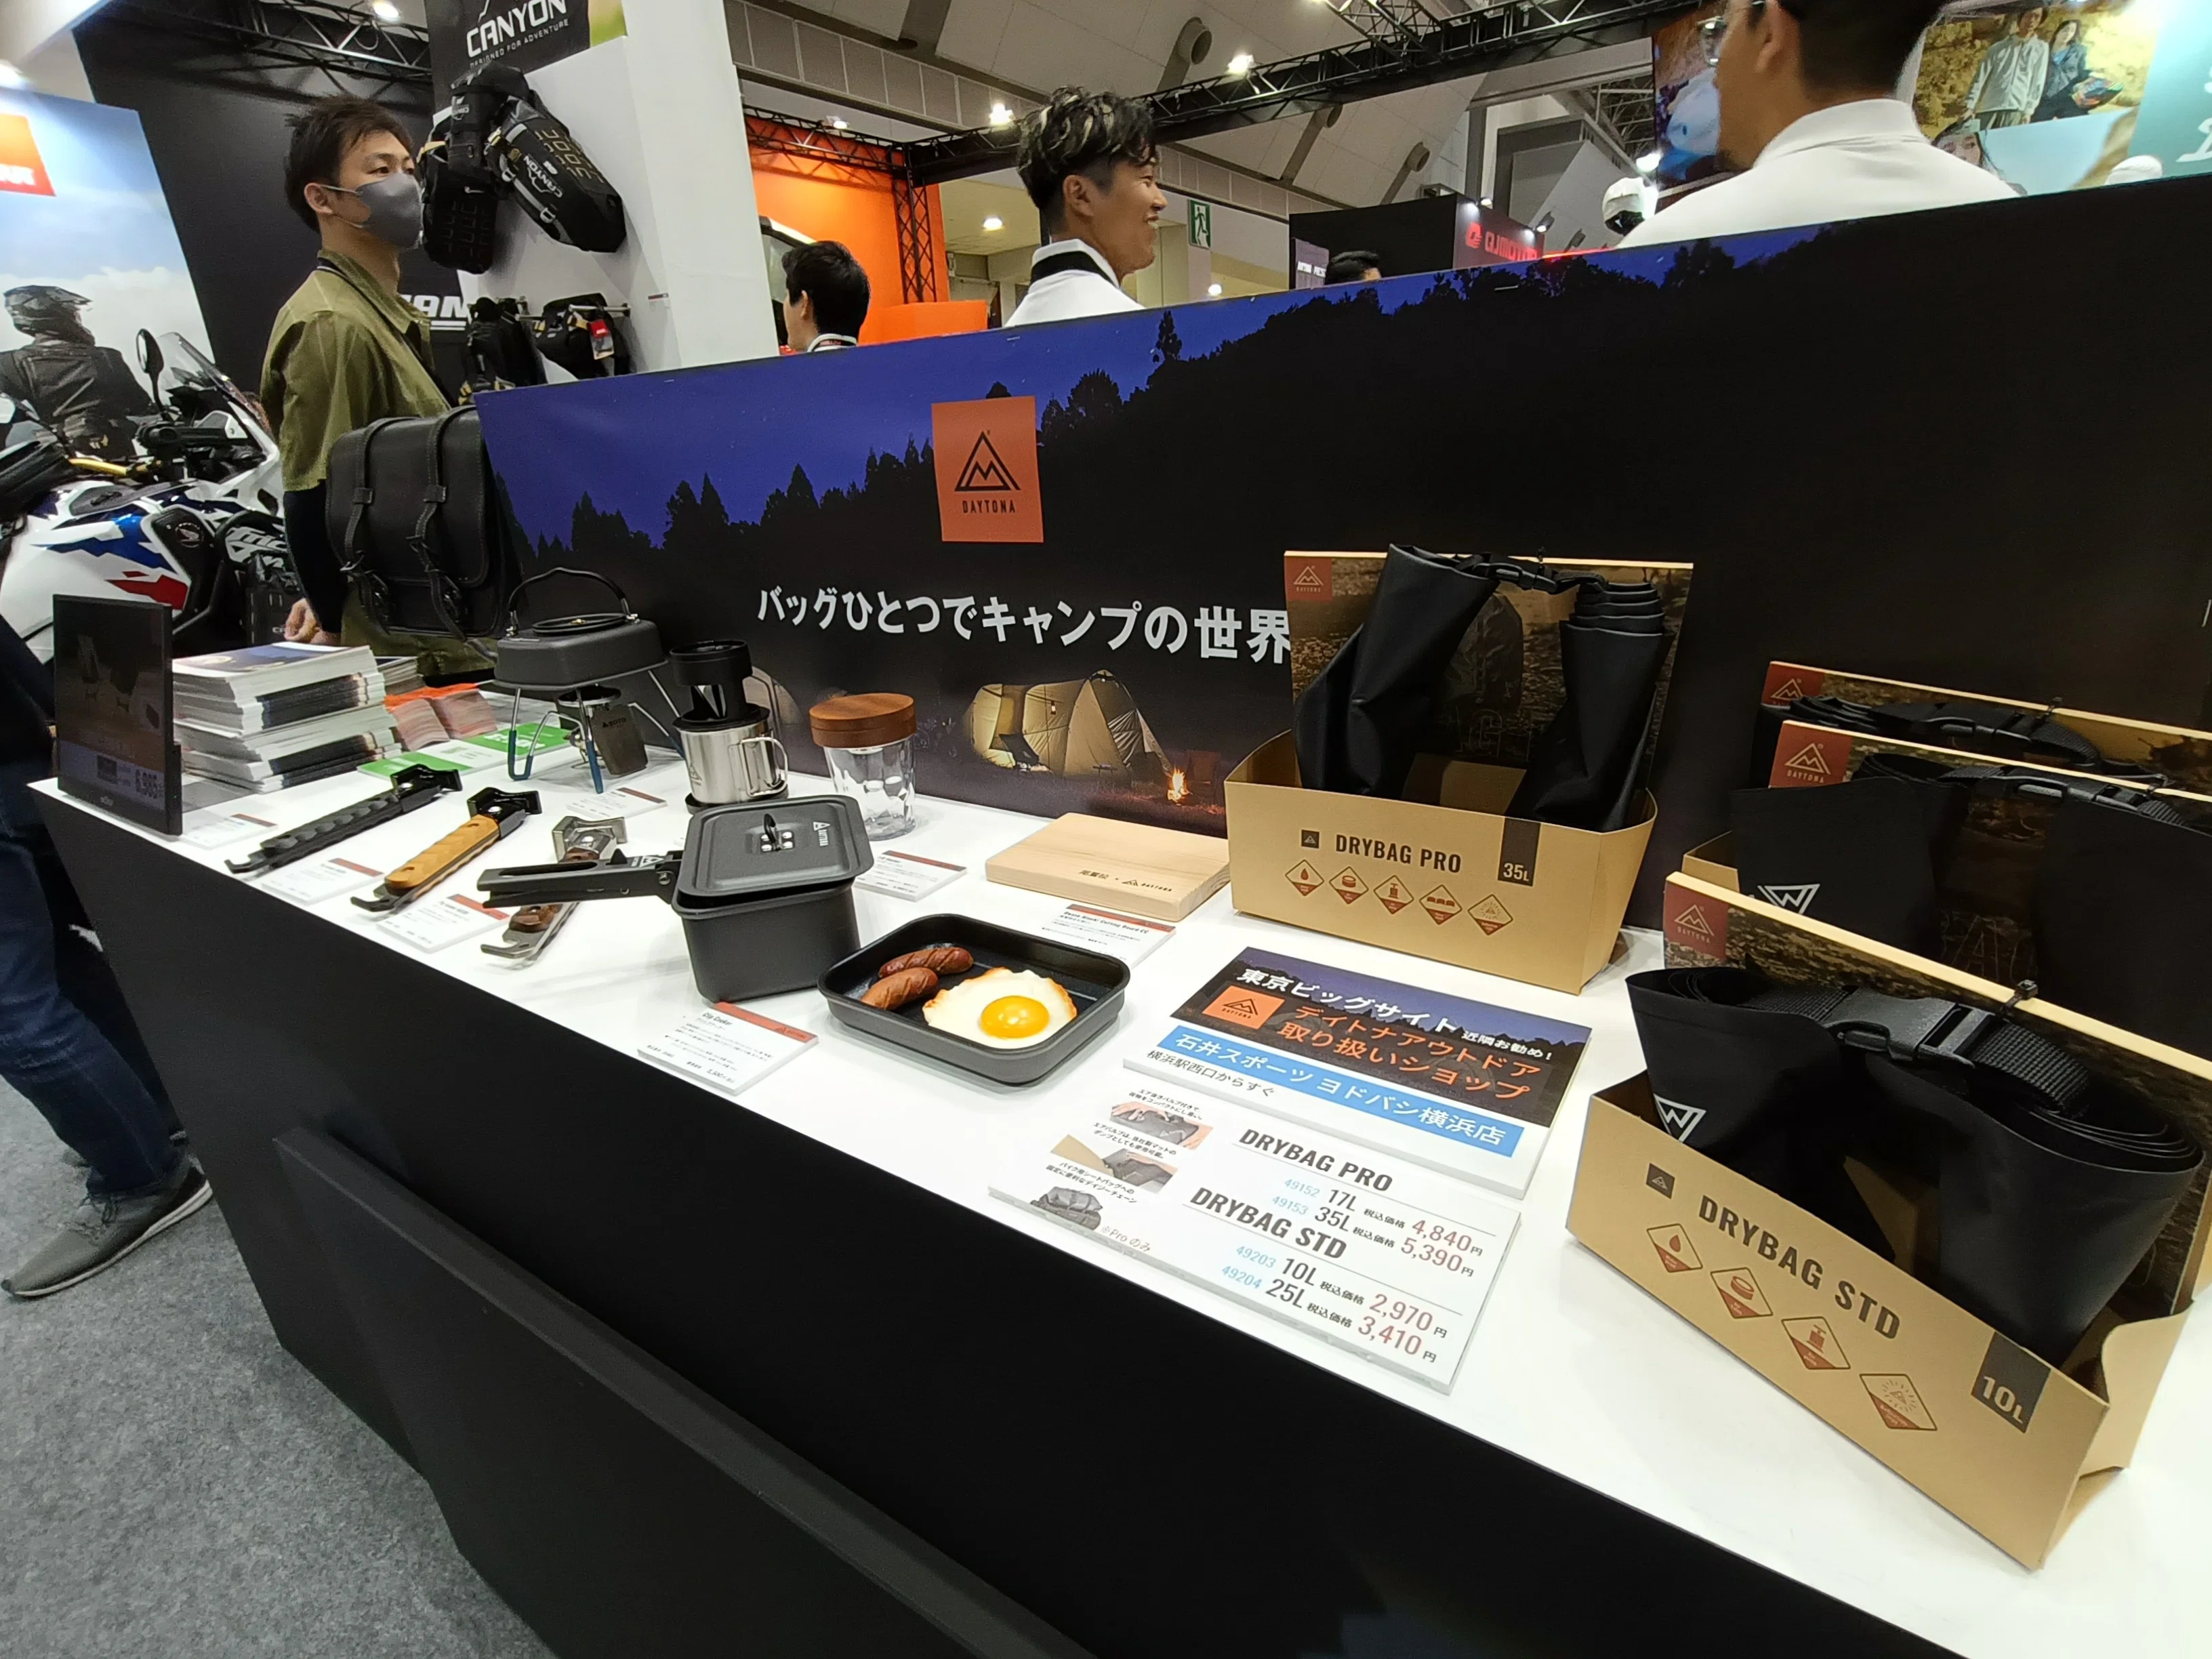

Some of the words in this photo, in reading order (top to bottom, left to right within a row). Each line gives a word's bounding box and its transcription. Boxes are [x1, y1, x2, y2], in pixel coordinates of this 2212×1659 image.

[466, 0, 567, 58] CANYON
[507, 39, 521, 54] FOR
[524, 18, 569, 44] ADVENTURE
[523, 155, 563, 198] CANYON
[962, 499, 1016, 514] DAYTONA
[756, 586, 1291, 665] バッグひとつでキャンプの世界
[1786, 769, 1824, 783] DAYTONA
[1336, 834, 1412, 865] DRYBAG
[1420, 847, 1462, 874] PRO
[1502, 861, 1530, 882] 35L
[1236, 968, 1457, 1033] 東京ビッグサイト
[1277, 1021, 1531, 1099] 取り扱いショップ
[1295, 1006, 1541, 1077] デイトナアウトドア
[1146, 1049, 1275, 1097] 横浜駅西口からすぐ
[1175, 1033, 1314, 1082] 石井スポーツ
[1316, 1077, 1507, 1146] ヨドバシ横浜店
[1238, 1128, 1335, 1172] DRYBAG
[1338, 1161, 1393, 1192] PRO
[1189, 1187, 1292, 1239] DRYBAG
[1295, 1227, 1347, 1259] STD
[1271, 1195, 1309, 1216] 49153
[1314, 1206, 1350, 1233] 35L
[1353, 1226, 1395, 1248] 税込価格
[1284, 1178, 1320, 1198] 49152
[1328, 1189, 1357, 1212] 17L
[1363, 1208, 1406, 1229] 税込価格
[1235, 1245, 1277, 1269] 49203
[1282, 1257, 1317, 1287] 10L
[1319, 1280, 1365, 1306] 税込価格
[1698, 1194, 1824, 1290] DRYBAG
[1834, 1279, 1901, 1340] STD
[1221, 1265, 1263, 1290] 49204
[1265, 1278, 1305, 1309] 25L
[1307, 1302, 1353, 1328] 税込価格
[1983, 1375, 2024, 1425] 10L
